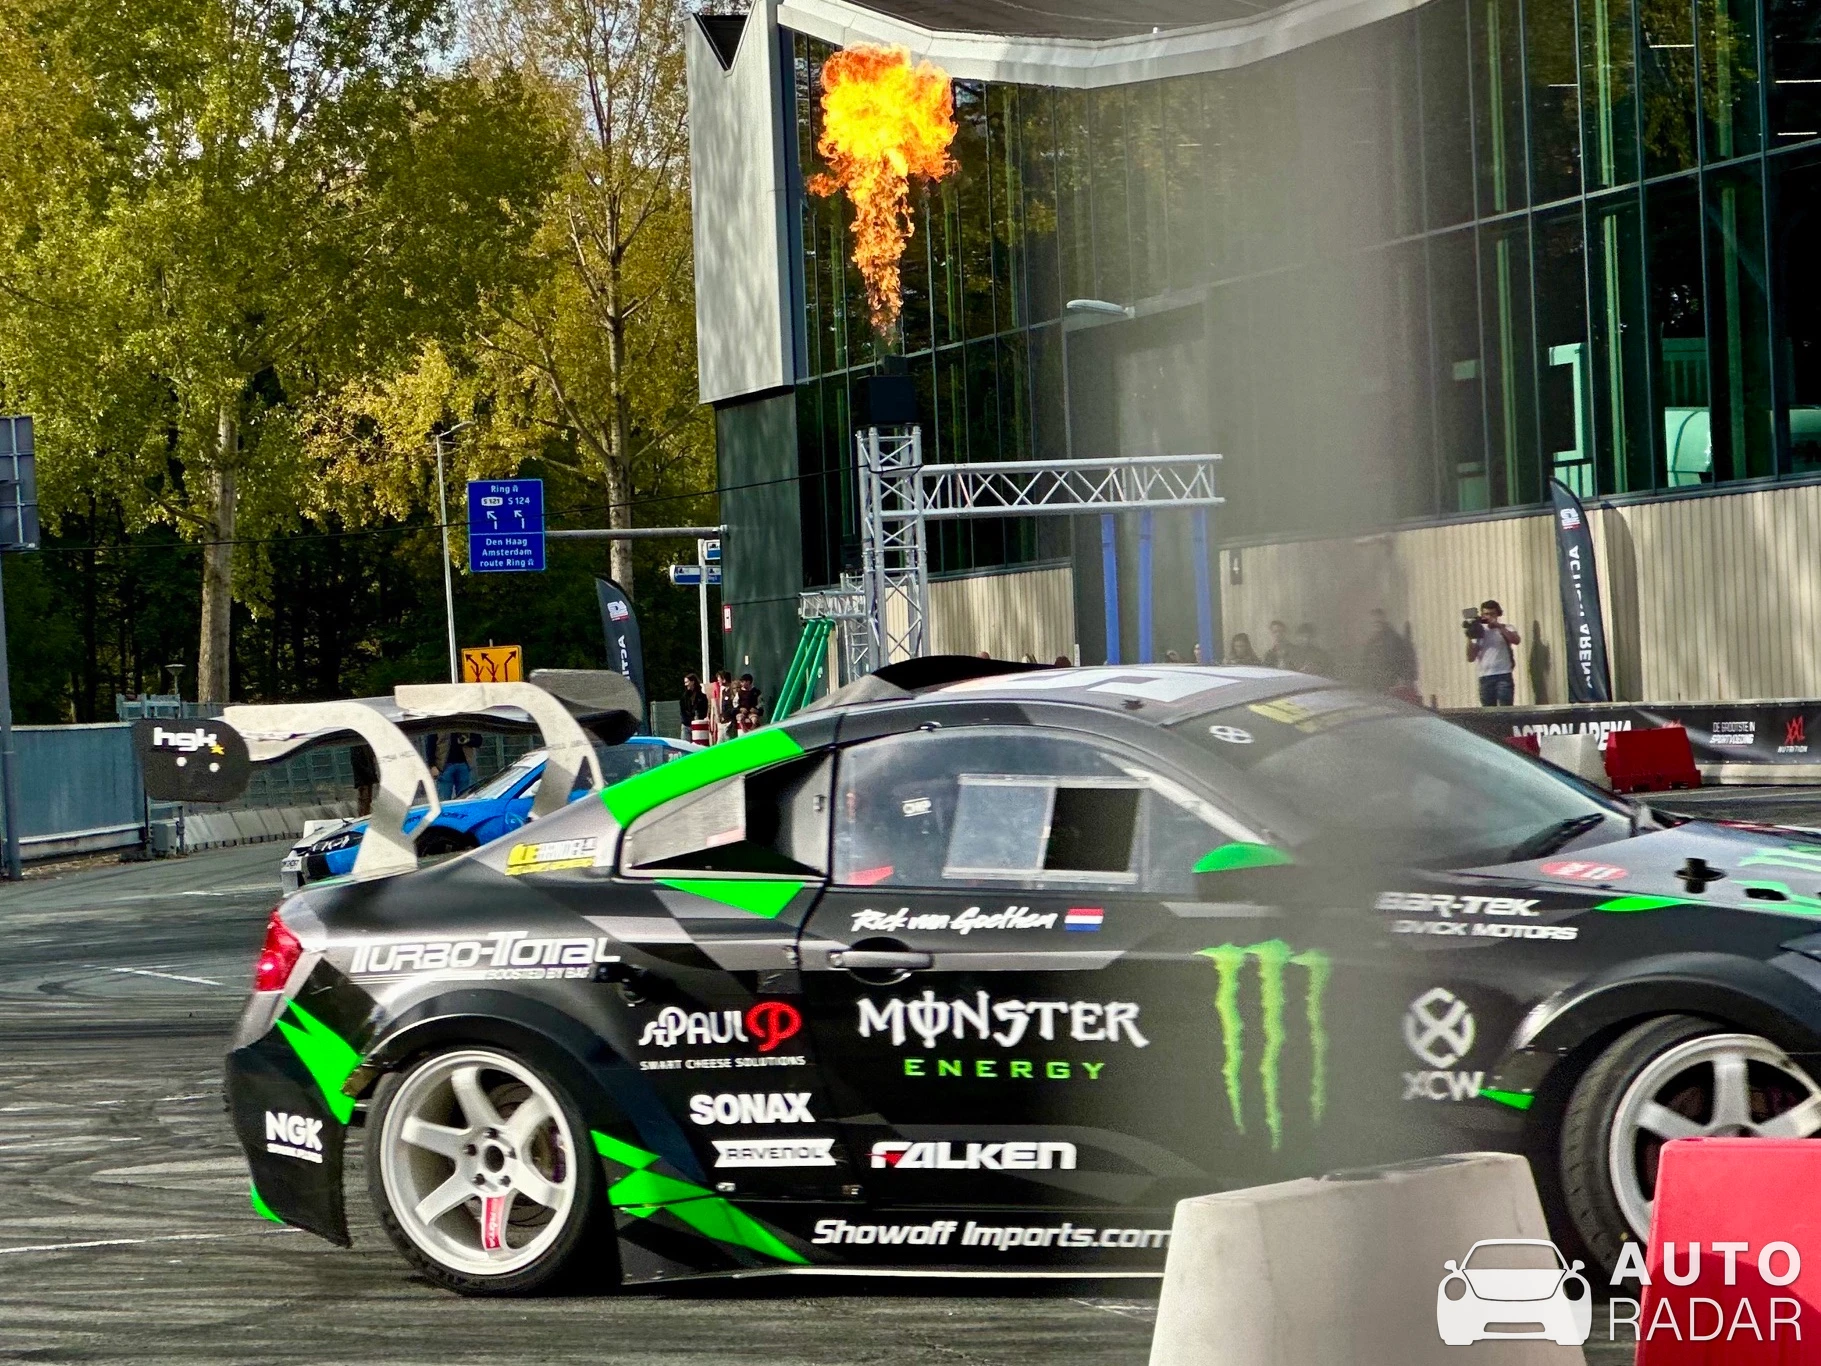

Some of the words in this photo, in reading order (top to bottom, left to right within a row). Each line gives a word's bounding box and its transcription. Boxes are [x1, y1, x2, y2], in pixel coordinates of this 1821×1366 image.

[491, 485, 510, 494] Ring
[515, 497, 530, 505] 124
[482, 548, 532, 557] Amsterdam
[485, 538, 503, 546] Den
[505, 538, 528, 547] Haag
[480, 559, 504, 567] route
[506, 558, 526, 567] Ring
[153, 727, 218, 752] hgk
[1471, 922, 1579, 940] MOTORS
[856, 989, 1150, 1049] MONSTER
[639, 1060, 683, 1071] SMART
[685, 1058, 732, 1069] CHEESE
[734, 1056, 807, 1067] SOLUTIONS
[904, 1058, 1105, 1080] ENERGY
[689, 1092, 816, 1125] SONAX
[265, 1110, 323, 1151] NGK
[870, 1141, 1077, 1170] FALKEN
[811, 1219, 958, 1245] Showoff
[961, 1221, 1173, 1251] Imports.com
